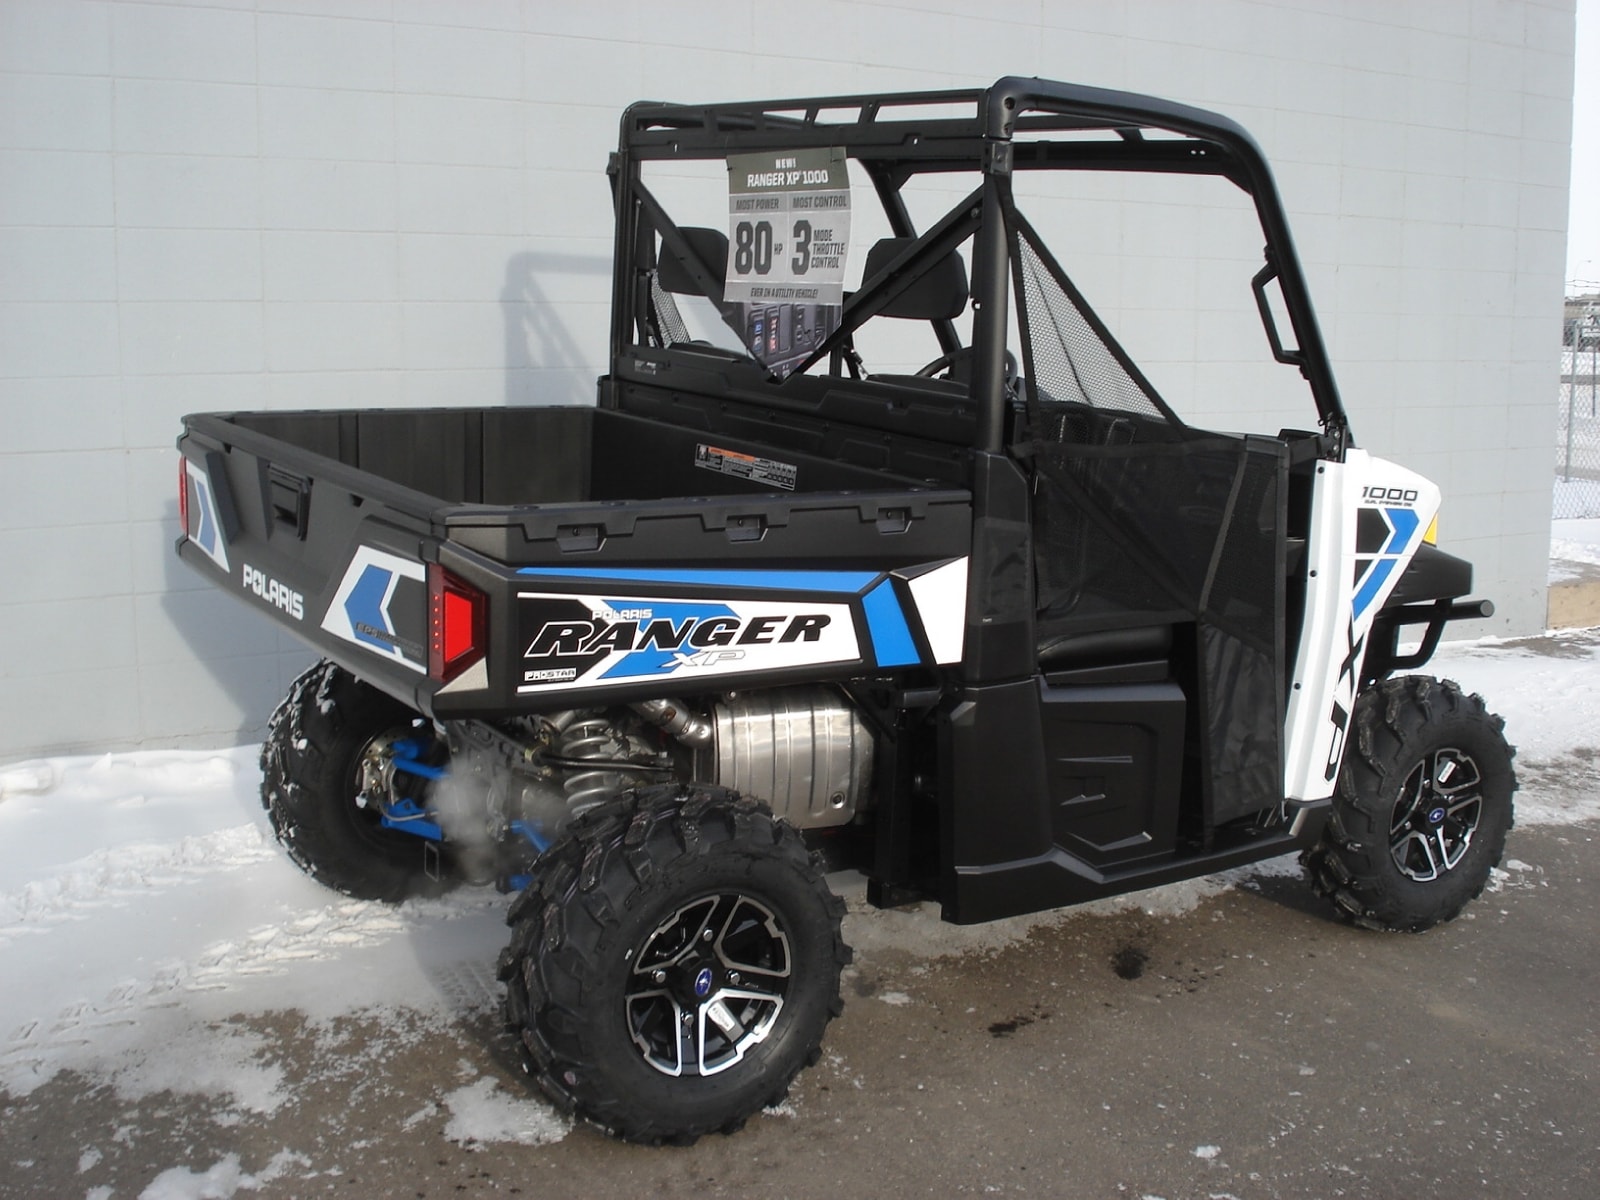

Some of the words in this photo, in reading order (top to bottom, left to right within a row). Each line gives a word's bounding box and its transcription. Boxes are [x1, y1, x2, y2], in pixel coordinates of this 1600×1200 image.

[775, 158, 797, 169] NEW!
[747, 172, 785, 187] RANGER
[802, 169, 829, 185] 1000
[736, 199, 754, 210] MOST
[755, 198, 779, 209] POWER
[792, 197, 812, 208] MOST
[813, 196, 847, 208] CONTROL
[813, 229, 833, 241] MODE
[735, 221, 773, 275] 80
[774, 243, 783, 255] HP
[791, 220, 812, 275] 3
[812, 243, 845, 255] THROTTLE
[810, 257, 840, 268] CONTROL
[1362, 486, 1418, 501] 1000
[243, 563, 304, 621] POLARIS
[592, 607, 653, 620] POLARIS
[523, 613, 832, 658] RANGER
[656, 649, 747, 669] XP
